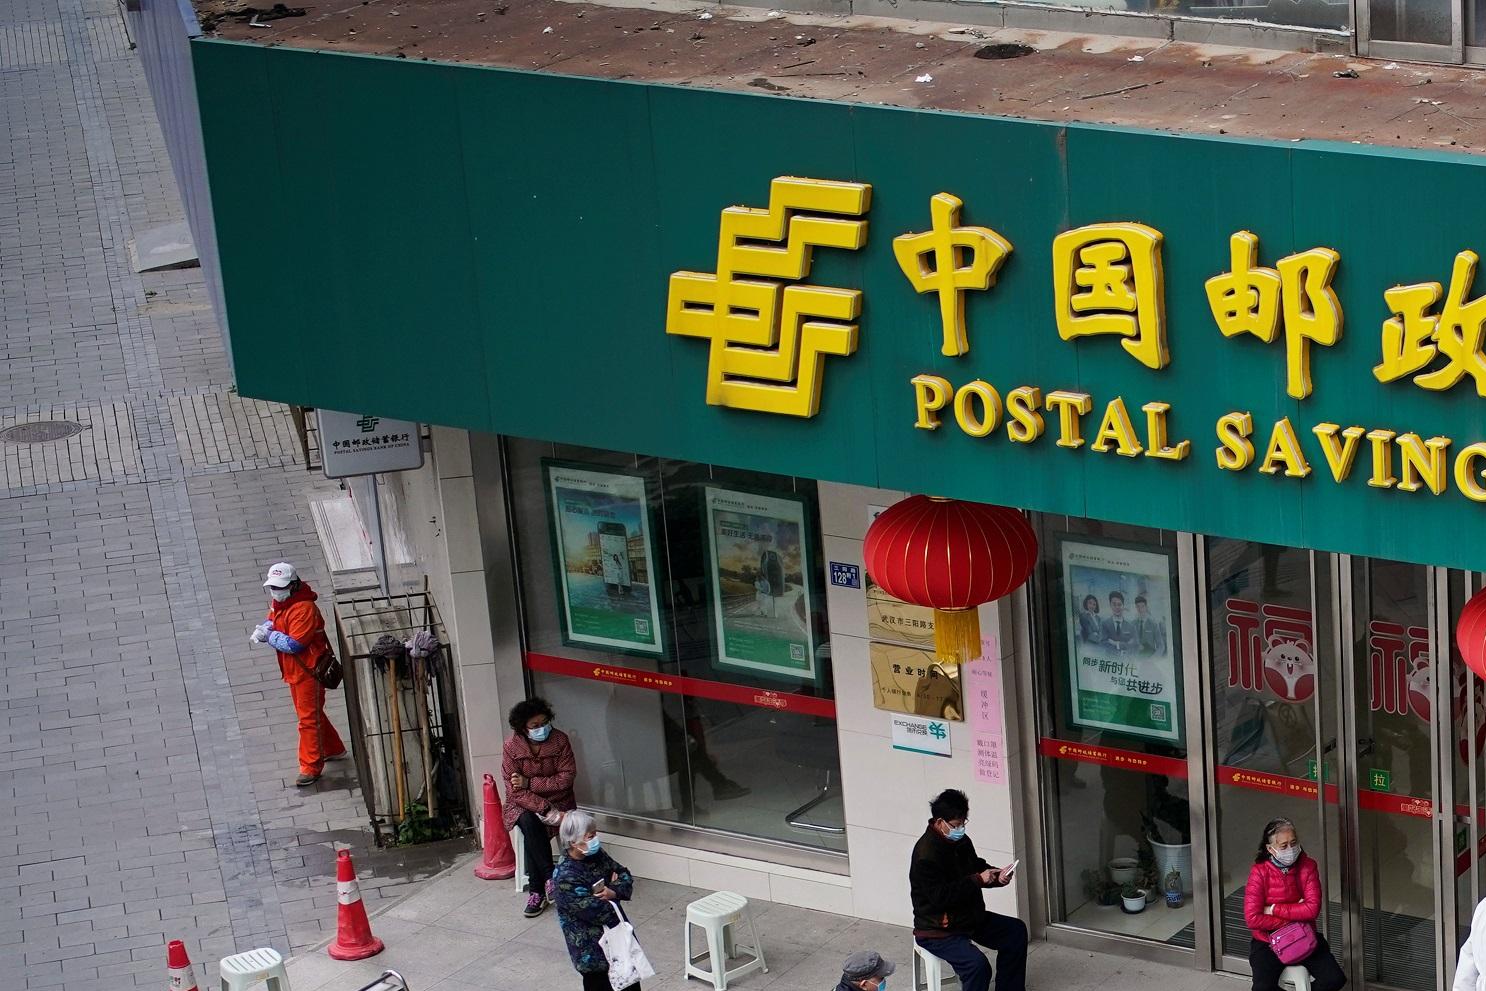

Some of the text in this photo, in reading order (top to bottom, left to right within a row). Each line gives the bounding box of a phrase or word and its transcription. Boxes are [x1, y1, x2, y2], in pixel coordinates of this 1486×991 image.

[910, 373, 1191, 462] POSTAL
[332, 432, 410, 449] 中国邮政储蓄银行
[833, 571, 847, 585] 128
[892, 663, 939, 680] 营业时间
[893, 719, 927, 730] EXCHANGE
[1373, 773, 1386, 787] 拉
